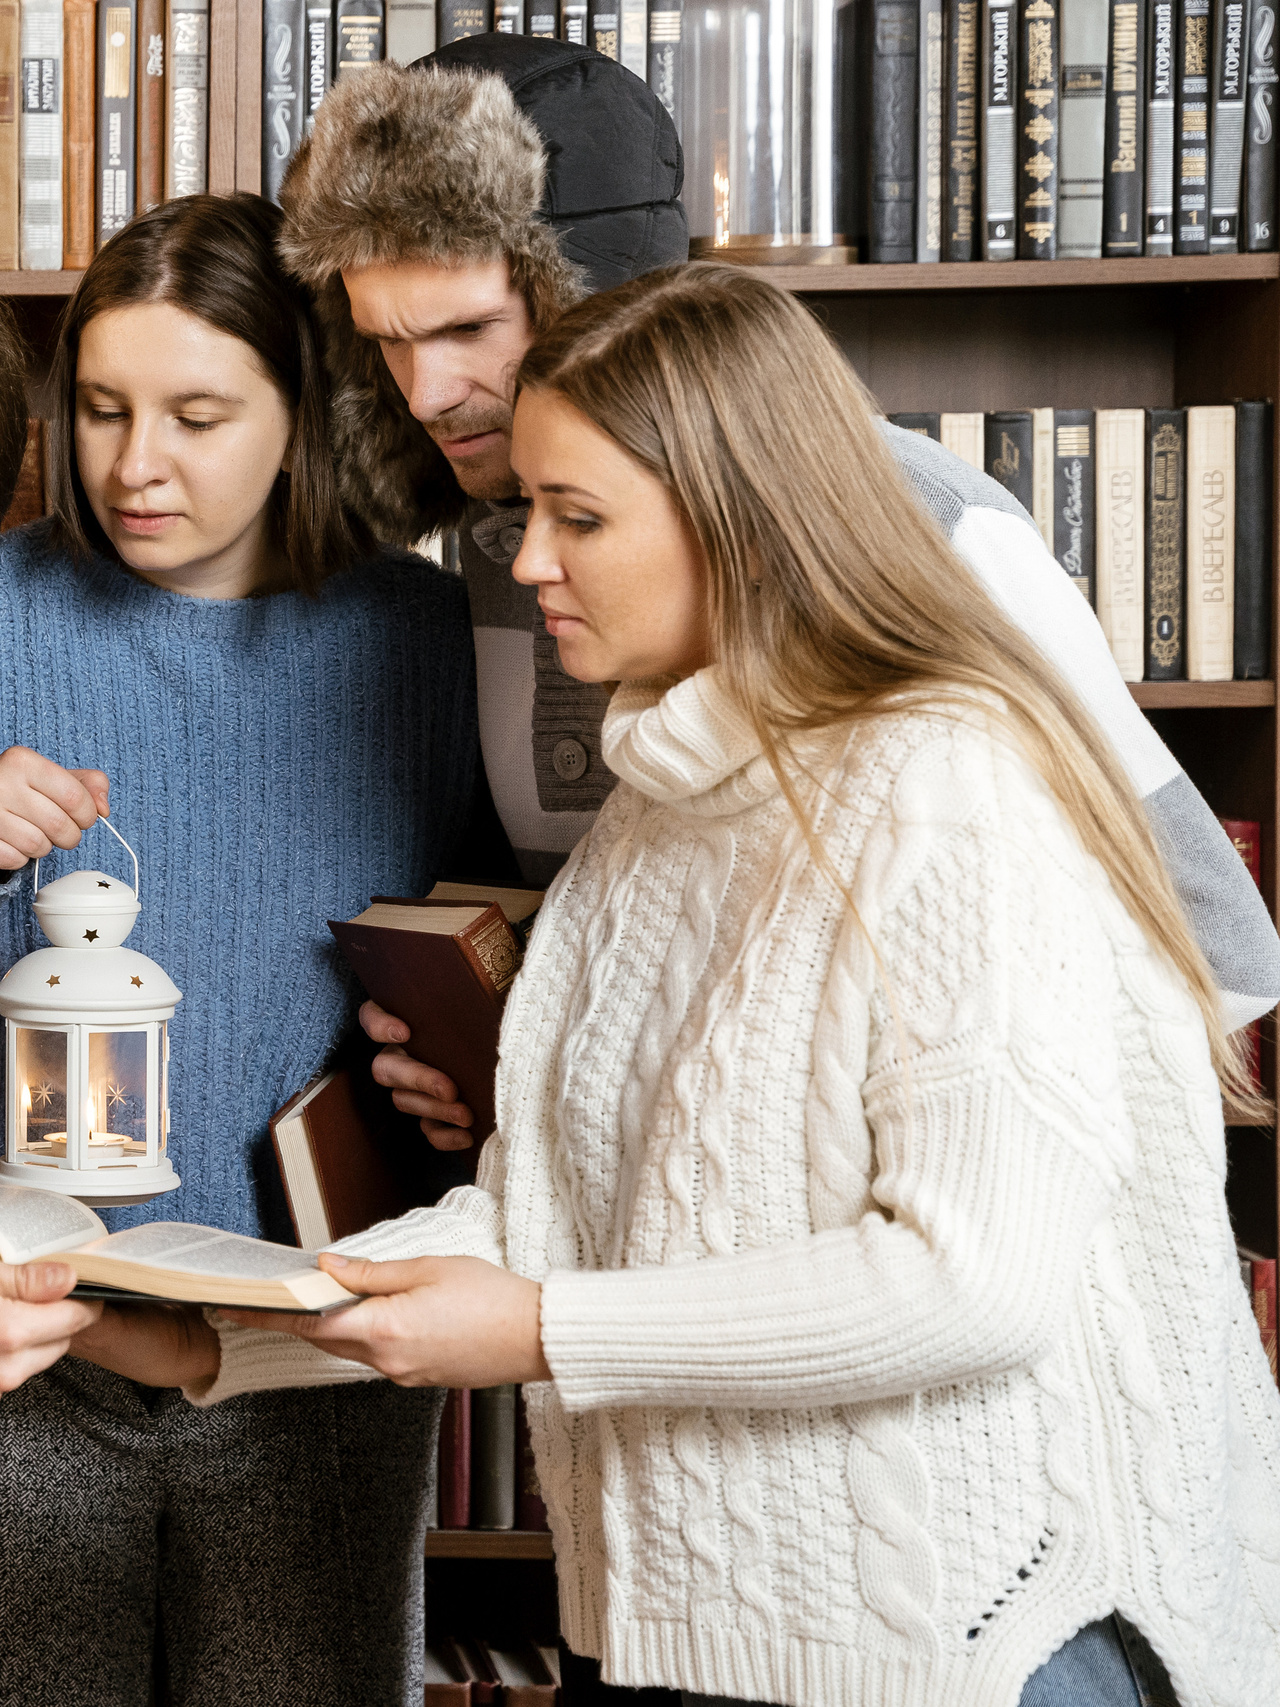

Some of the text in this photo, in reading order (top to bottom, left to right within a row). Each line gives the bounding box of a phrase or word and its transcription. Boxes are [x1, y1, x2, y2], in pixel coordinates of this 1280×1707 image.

[991, 10, 1009, 102] М.ГОРЬКИЙ
[1155, 3, 1172, 95] М.ГОРЬКИЙ
[1223, 2, 1243, 95] М.ГОРЬКИЙ
[1111, 3, 1138, 173] Василий ШУКШИН
[956, 100, 976, 137] АННА
[995, 223, 1006, 239] 6
[1120, 212, 1128, 233] 1
[1154, 219, 1165, 233] 4
[1188, 210, 1198, 225] 1
[1254, 221, 1270, 240] 16
[1203, 469, 1225, 584] ВЕРЕСАЕВ
[1063, 526, 1082, 575] Джон
